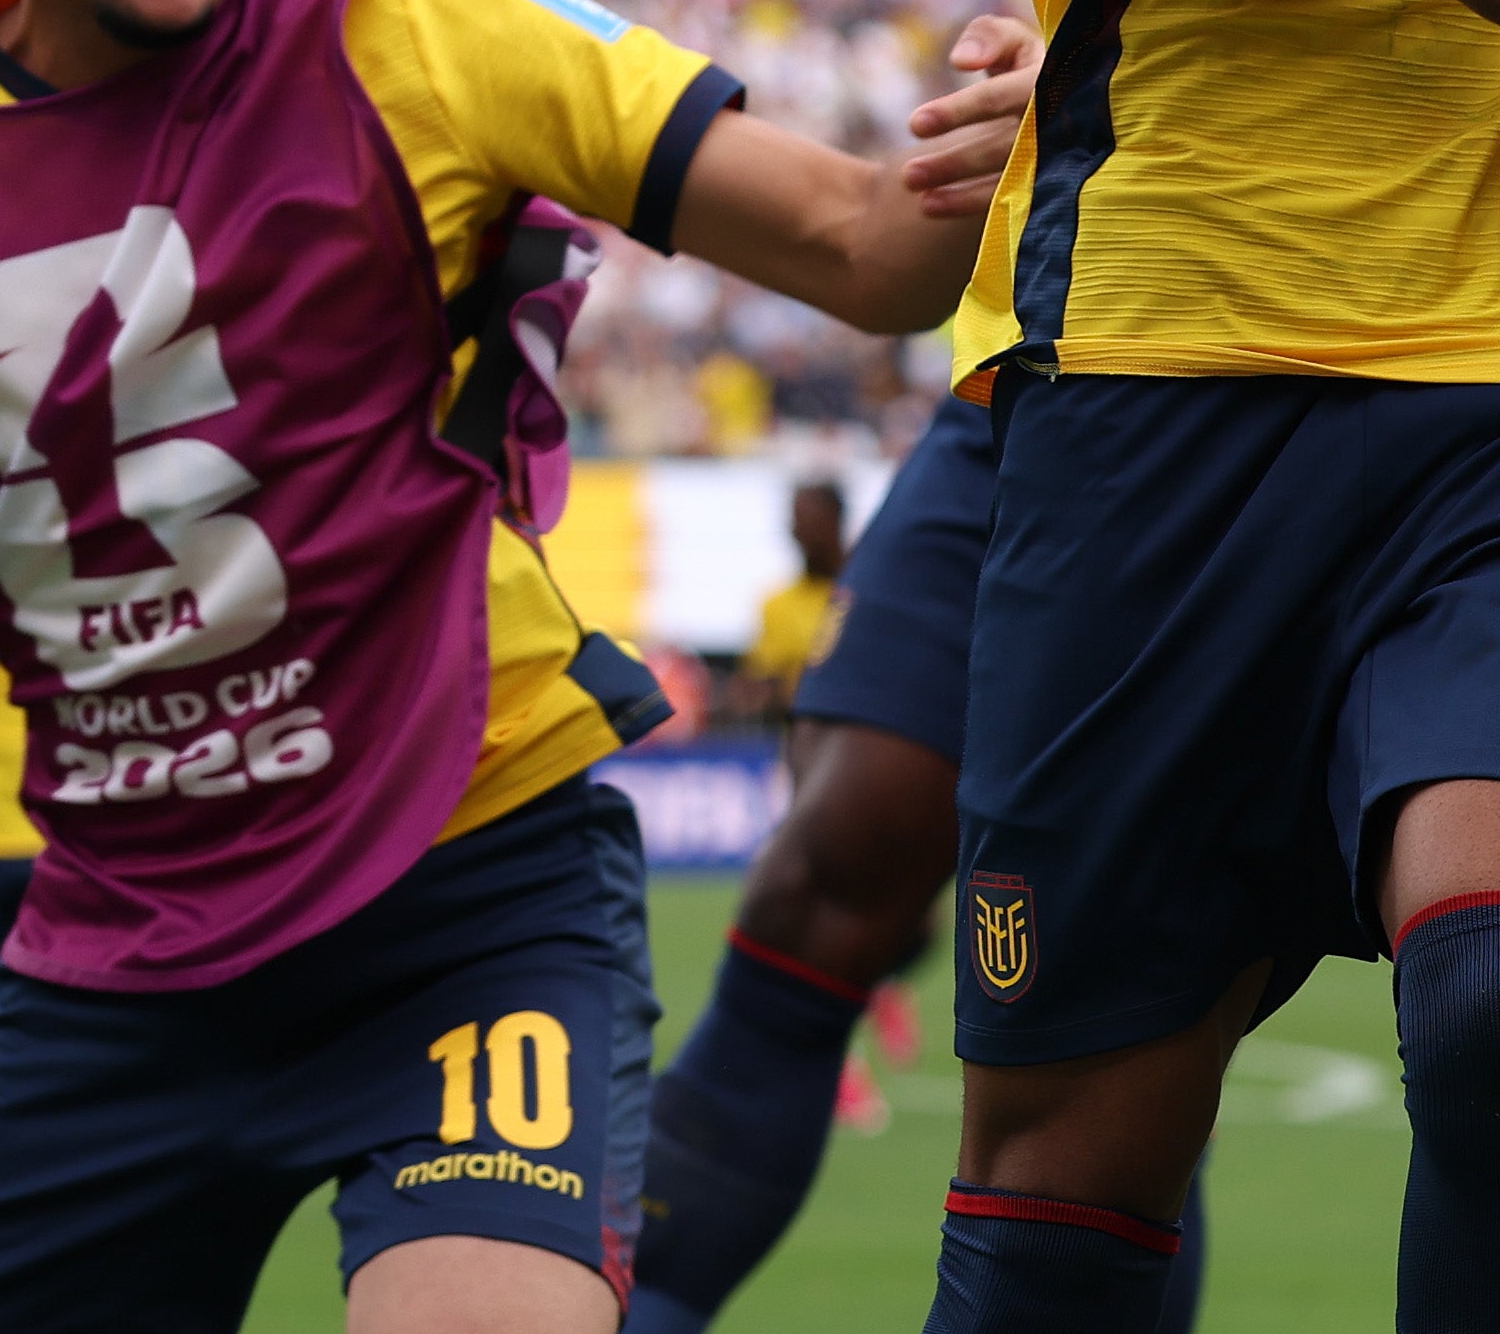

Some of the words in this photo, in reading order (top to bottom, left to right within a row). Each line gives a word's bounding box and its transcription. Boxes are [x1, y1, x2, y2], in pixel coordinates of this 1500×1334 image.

[79, 588, 204, 652] FIFA
[54, 690, 208, 738] WORLD
[215, 657, 315, 717] CUP
[51, 706, 333, 804] 2026
[428, 1010, 574, 1150] 10
[394, 1150, 584, 1200] marathon
